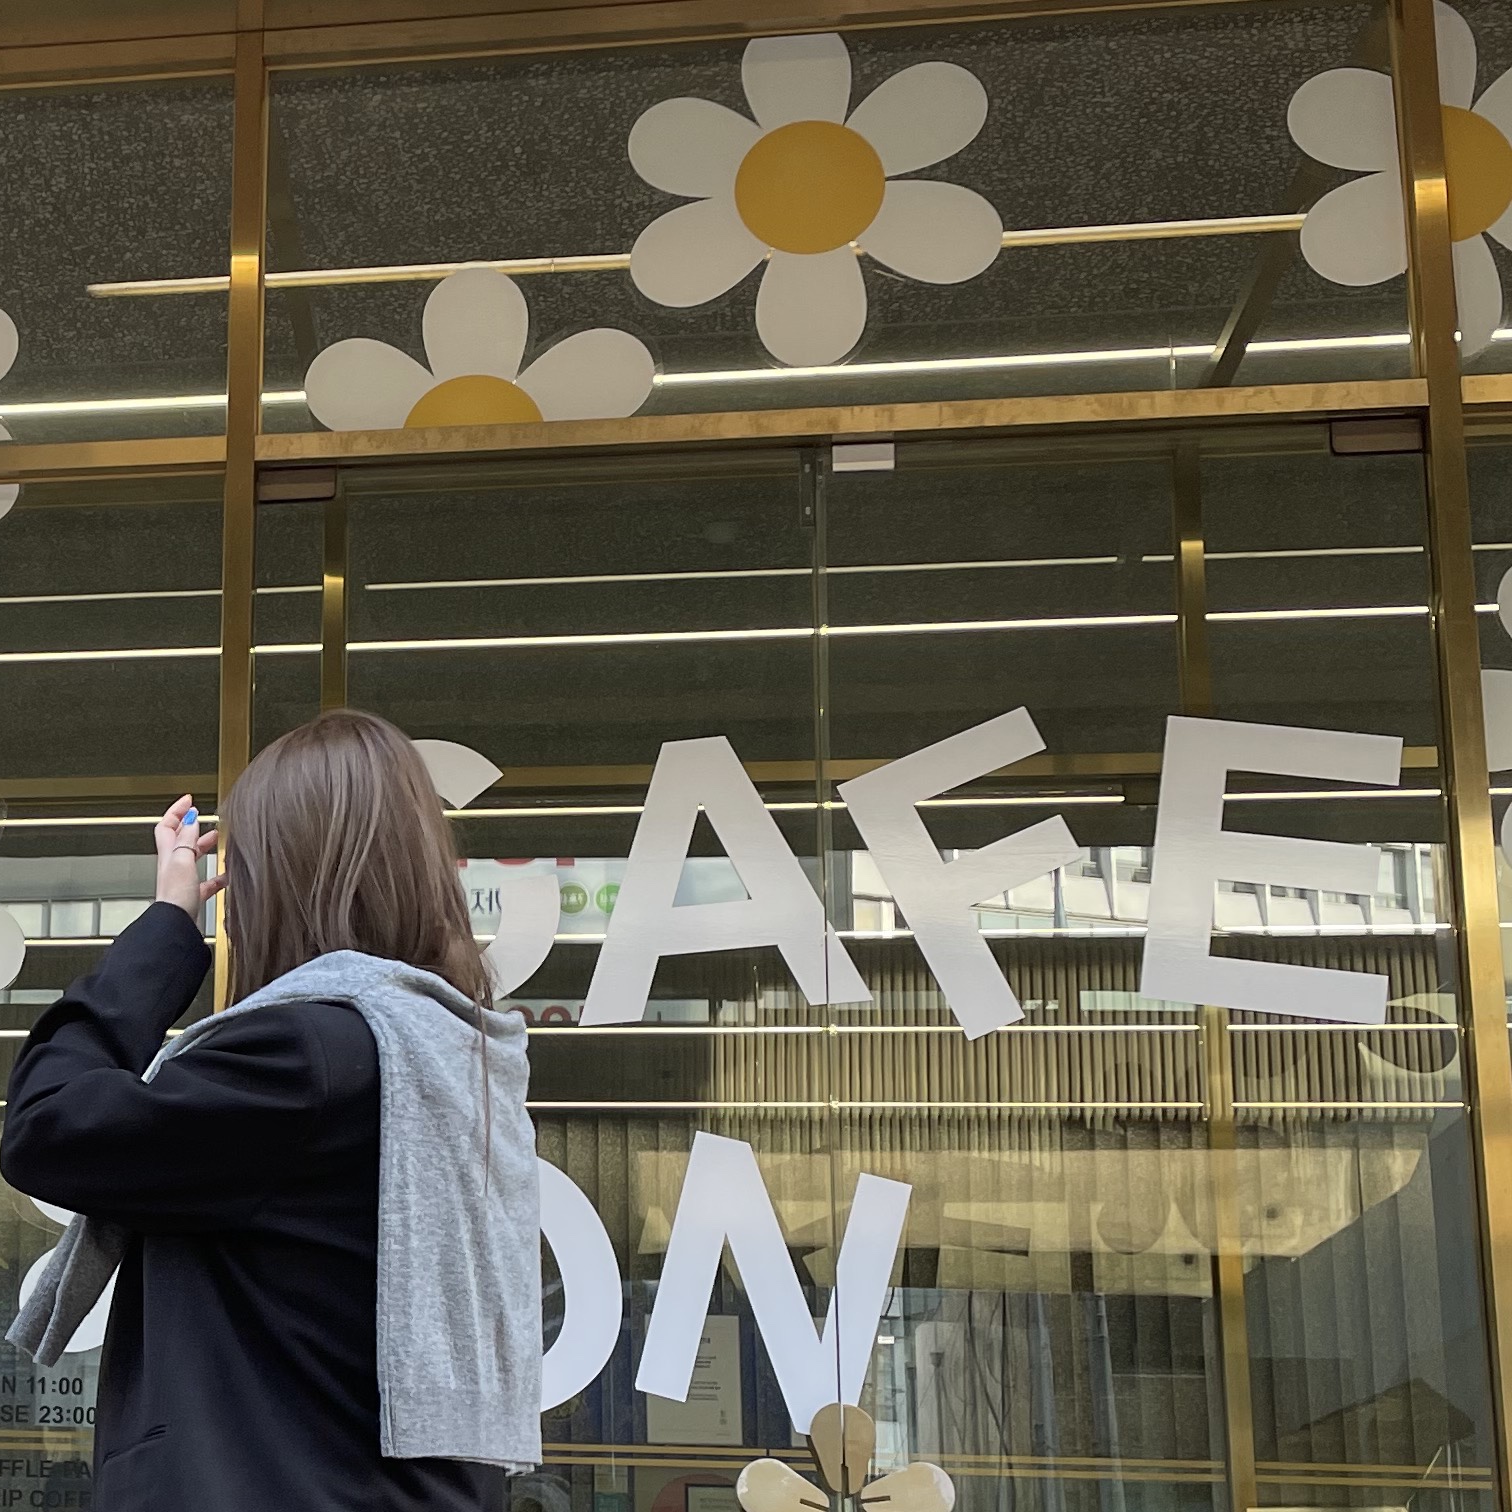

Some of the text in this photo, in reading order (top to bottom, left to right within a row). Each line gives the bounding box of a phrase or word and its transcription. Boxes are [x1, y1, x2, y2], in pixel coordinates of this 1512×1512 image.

[26, 1376, 83, 1395] 11:00
[38, 1405, 97, 1424] 23:00
[29, 1489, 92, 1508] COFF
